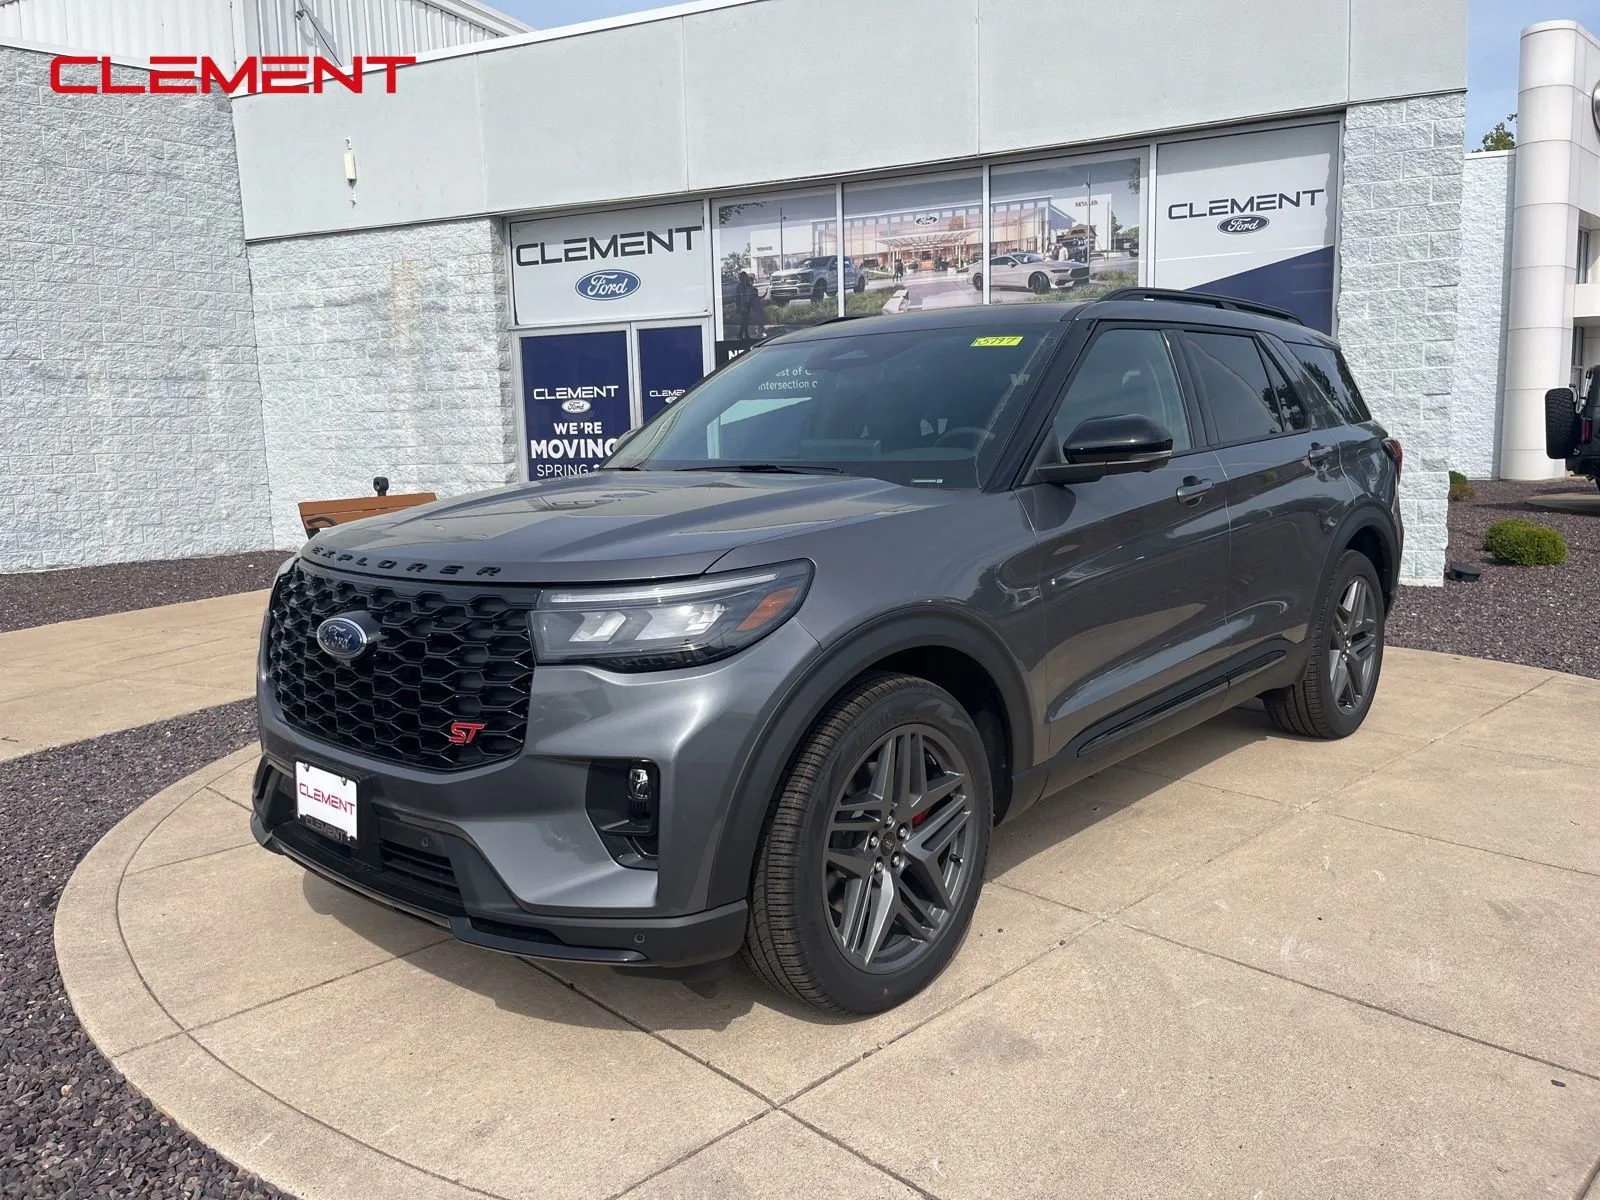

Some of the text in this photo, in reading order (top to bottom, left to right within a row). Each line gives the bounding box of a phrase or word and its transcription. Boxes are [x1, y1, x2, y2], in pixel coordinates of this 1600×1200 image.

[1168, 190, 1324, 220] CLEMENT
[516, 225, 702, 267] CLEMENT
[587, 274, 628, 296] Ford
[792, 366, 803, 376] of
[533, 385, 619, 400] CLEMENT
[649, 389, 686, 397] CLEME
[553, 422, 603, 435] WE'RE
[536, 464, 589, 477] SPRING
[312, 546, 502, 577] EXPLORER
[449, 722, 486, 743] ST
[299, 782, 355, 815] CLEMENT
